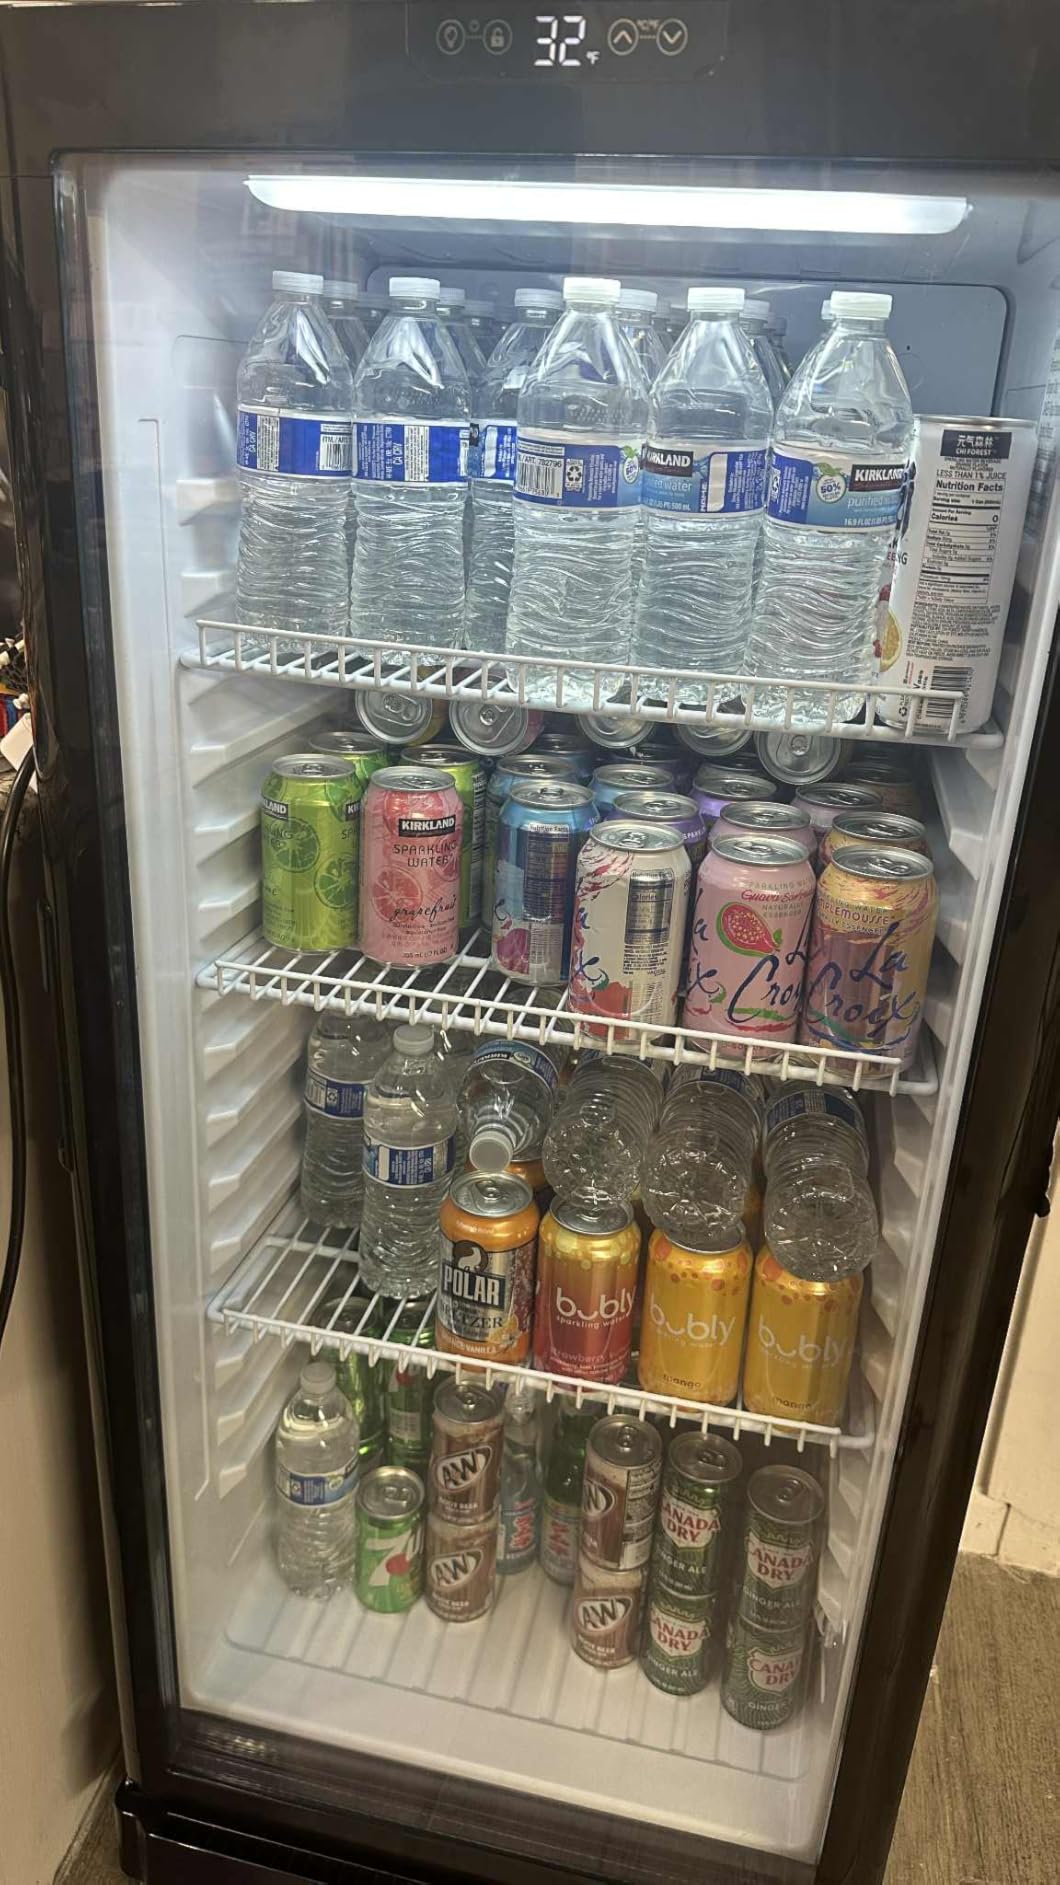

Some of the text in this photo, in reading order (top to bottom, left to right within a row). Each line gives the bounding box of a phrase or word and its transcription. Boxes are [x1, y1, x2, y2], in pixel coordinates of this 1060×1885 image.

[535, 16, 586, 66] 32
[967, 448, 992, 456] FOREST
[936, 469, 953, 478] LESS
[954, 470, 972, 478] THAN
[986, 472, 1007, 480] JUICE
[664, 480, 693, 492] water
[820, 482, 841, 493] 50%
[936, 479, 1003, 492] Nutrition Facts
[931, 513, 999, 523] Calories 0
[264, 799, 287, 814] LAND
[401, 817, 455, 831] KIRKLAND
[393, 839, 458, 855] SPARKLING
[407, 855, 449, 868] WATER
[741, 889, 781, 902] Guava
[819, 897, 889, 926] PLEMOUSSE
[849, 920, 909, 991] La
[805, 961, 918, 1038] Croix
[444, 1265, 500, 1306] POLAR
[556, 1285, 637, 1321] bubly
[556, 1315, 601, 1329] sparkling
[650, 1293, 736, 1346] bubly
[759, 1313, 848, 1367] bubly
[465, 1344, 497, 1354] VANILLA
[663, 1502, 720, 1532] ANADA
[667, 1518, 701, 1543] DRY
[750, 1547, 812, 1569] ANADA
[757, 1562, 794, 1581] DRY
[652, 1616, 711, 1640] ANADA
[657, 1631, 692, 1651] DRY
[750, 1658, 794, 1674] CANA
